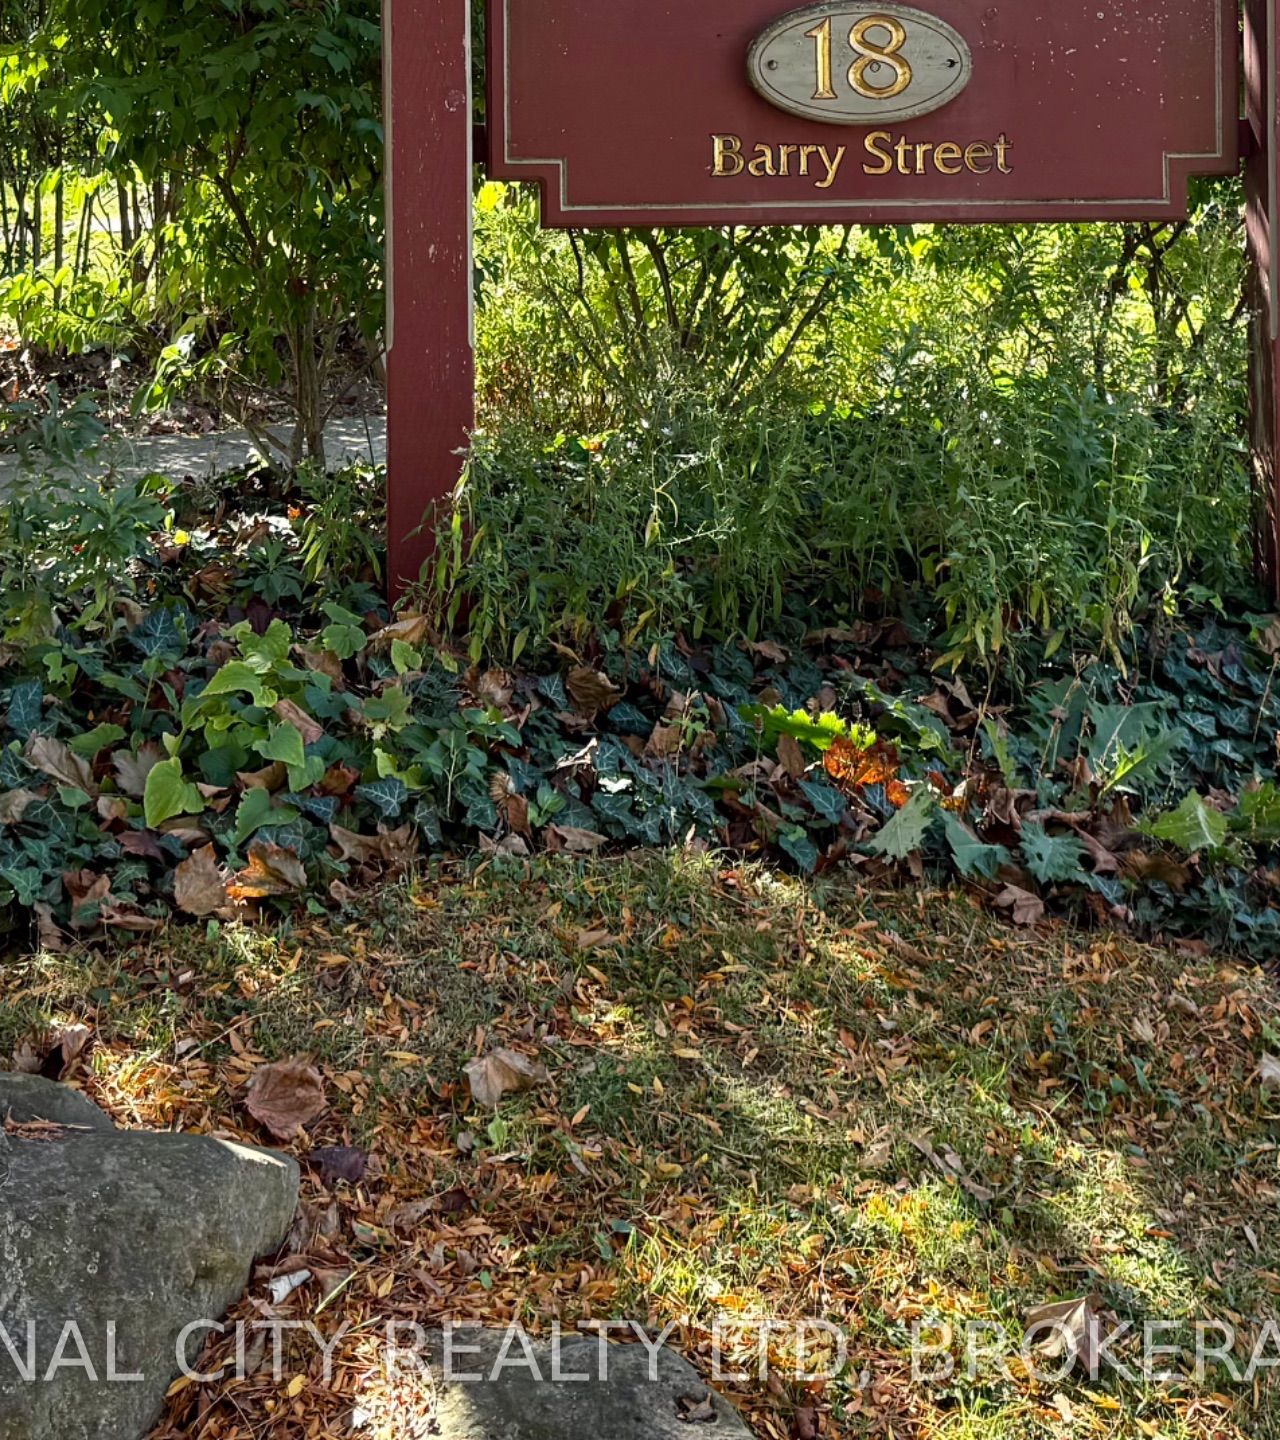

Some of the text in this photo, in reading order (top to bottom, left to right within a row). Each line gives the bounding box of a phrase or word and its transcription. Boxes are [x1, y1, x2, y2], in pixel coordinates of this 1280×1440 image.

[804, 13, 913, 101] 18
[710, 131, 1014, 189] Barry Street
